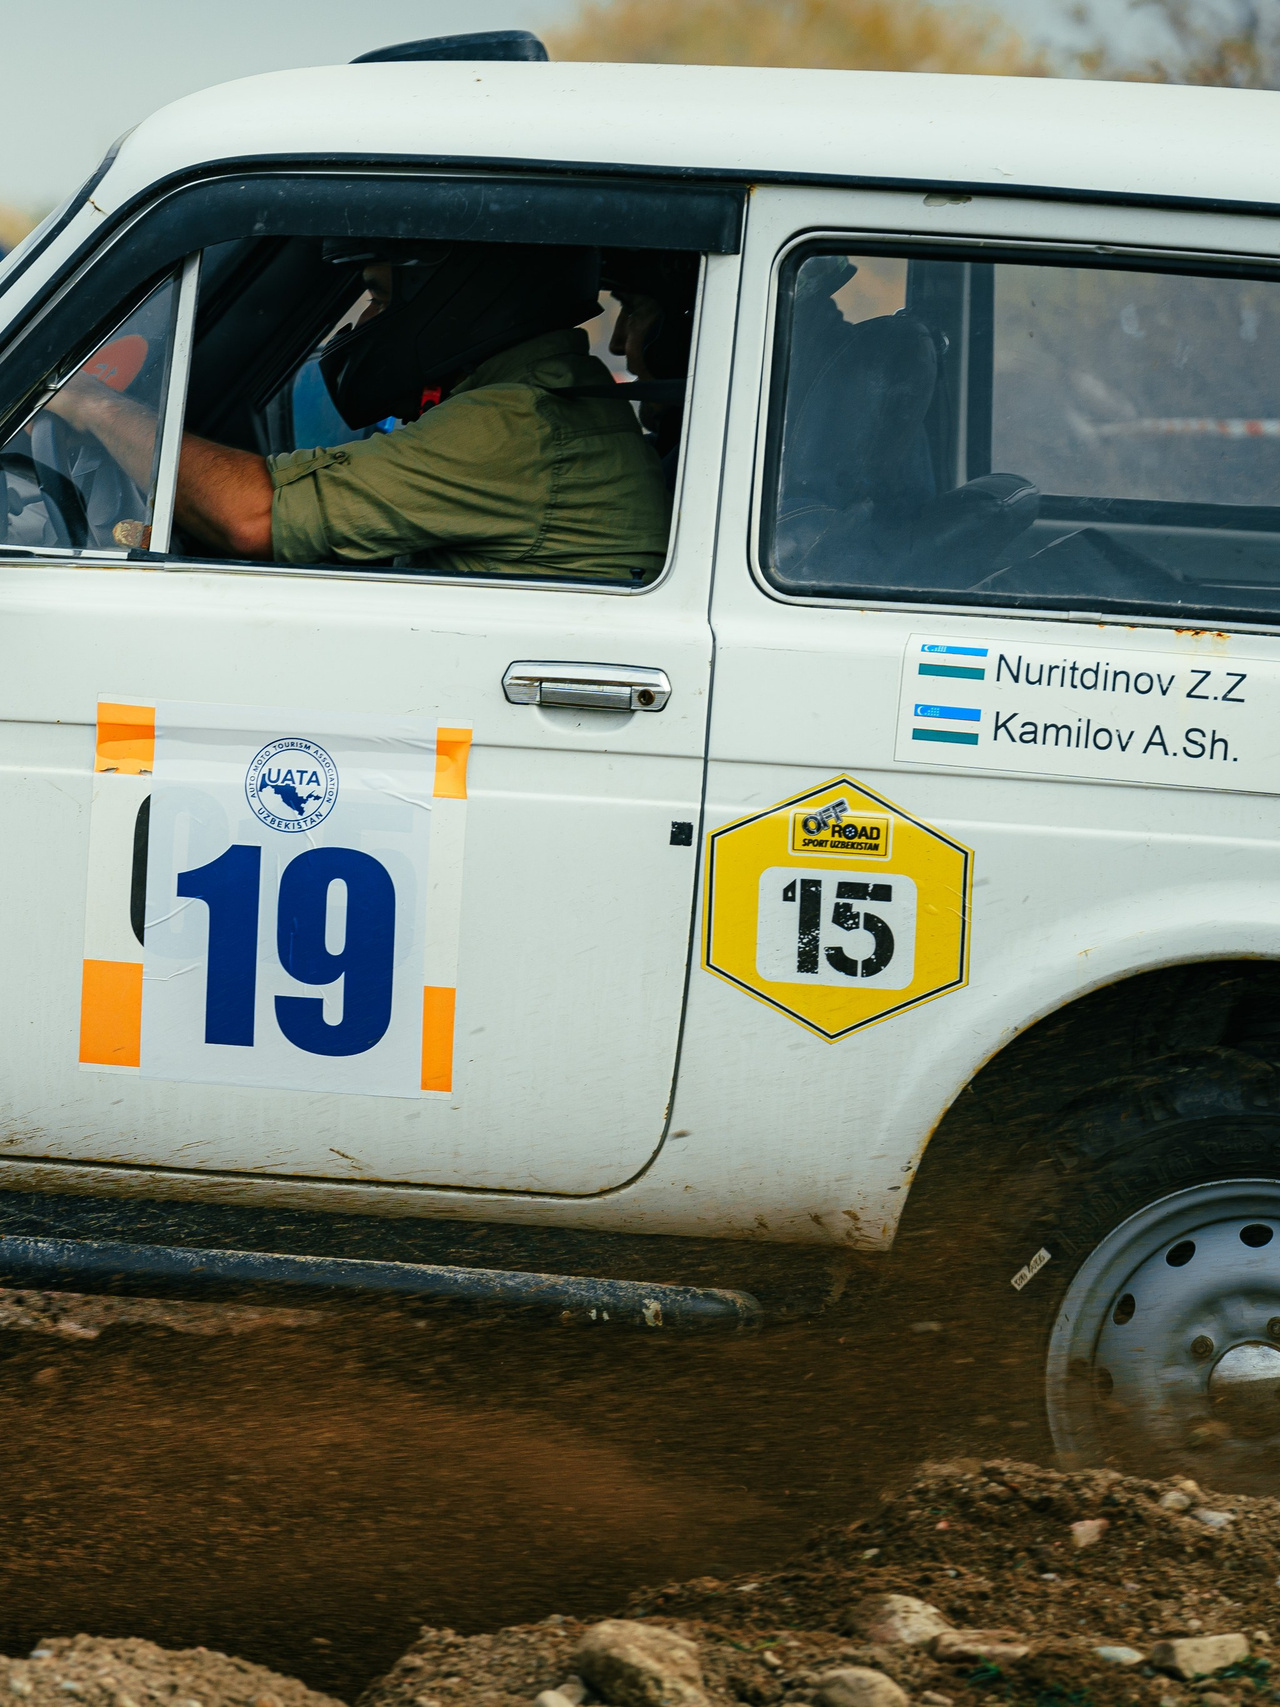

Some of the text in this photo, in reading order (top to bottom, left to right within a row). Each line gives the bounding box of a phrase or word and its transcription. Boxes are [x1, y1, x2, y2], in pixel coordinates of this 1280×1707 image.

[995, 653, 1248, 703] Nuritdinov Z.Z
[992, 711, 1239, 762] Kamilov A.Sh.
[249, 741, 335, 804] AUTO-MOTO TOURISM ASSOCIATION
[267, 768, 321, 787] UATA
[257, 807, 324, 830] UZBEKISTAN
[802, 798, 849, 837] OFF
[831, 824, 881, 840] ROAD
[802, 838, 880, 851] SPORT UZBEKISTAN
[176, 843, 396, 1057] 19
[782, 878, 895, 978] 15
